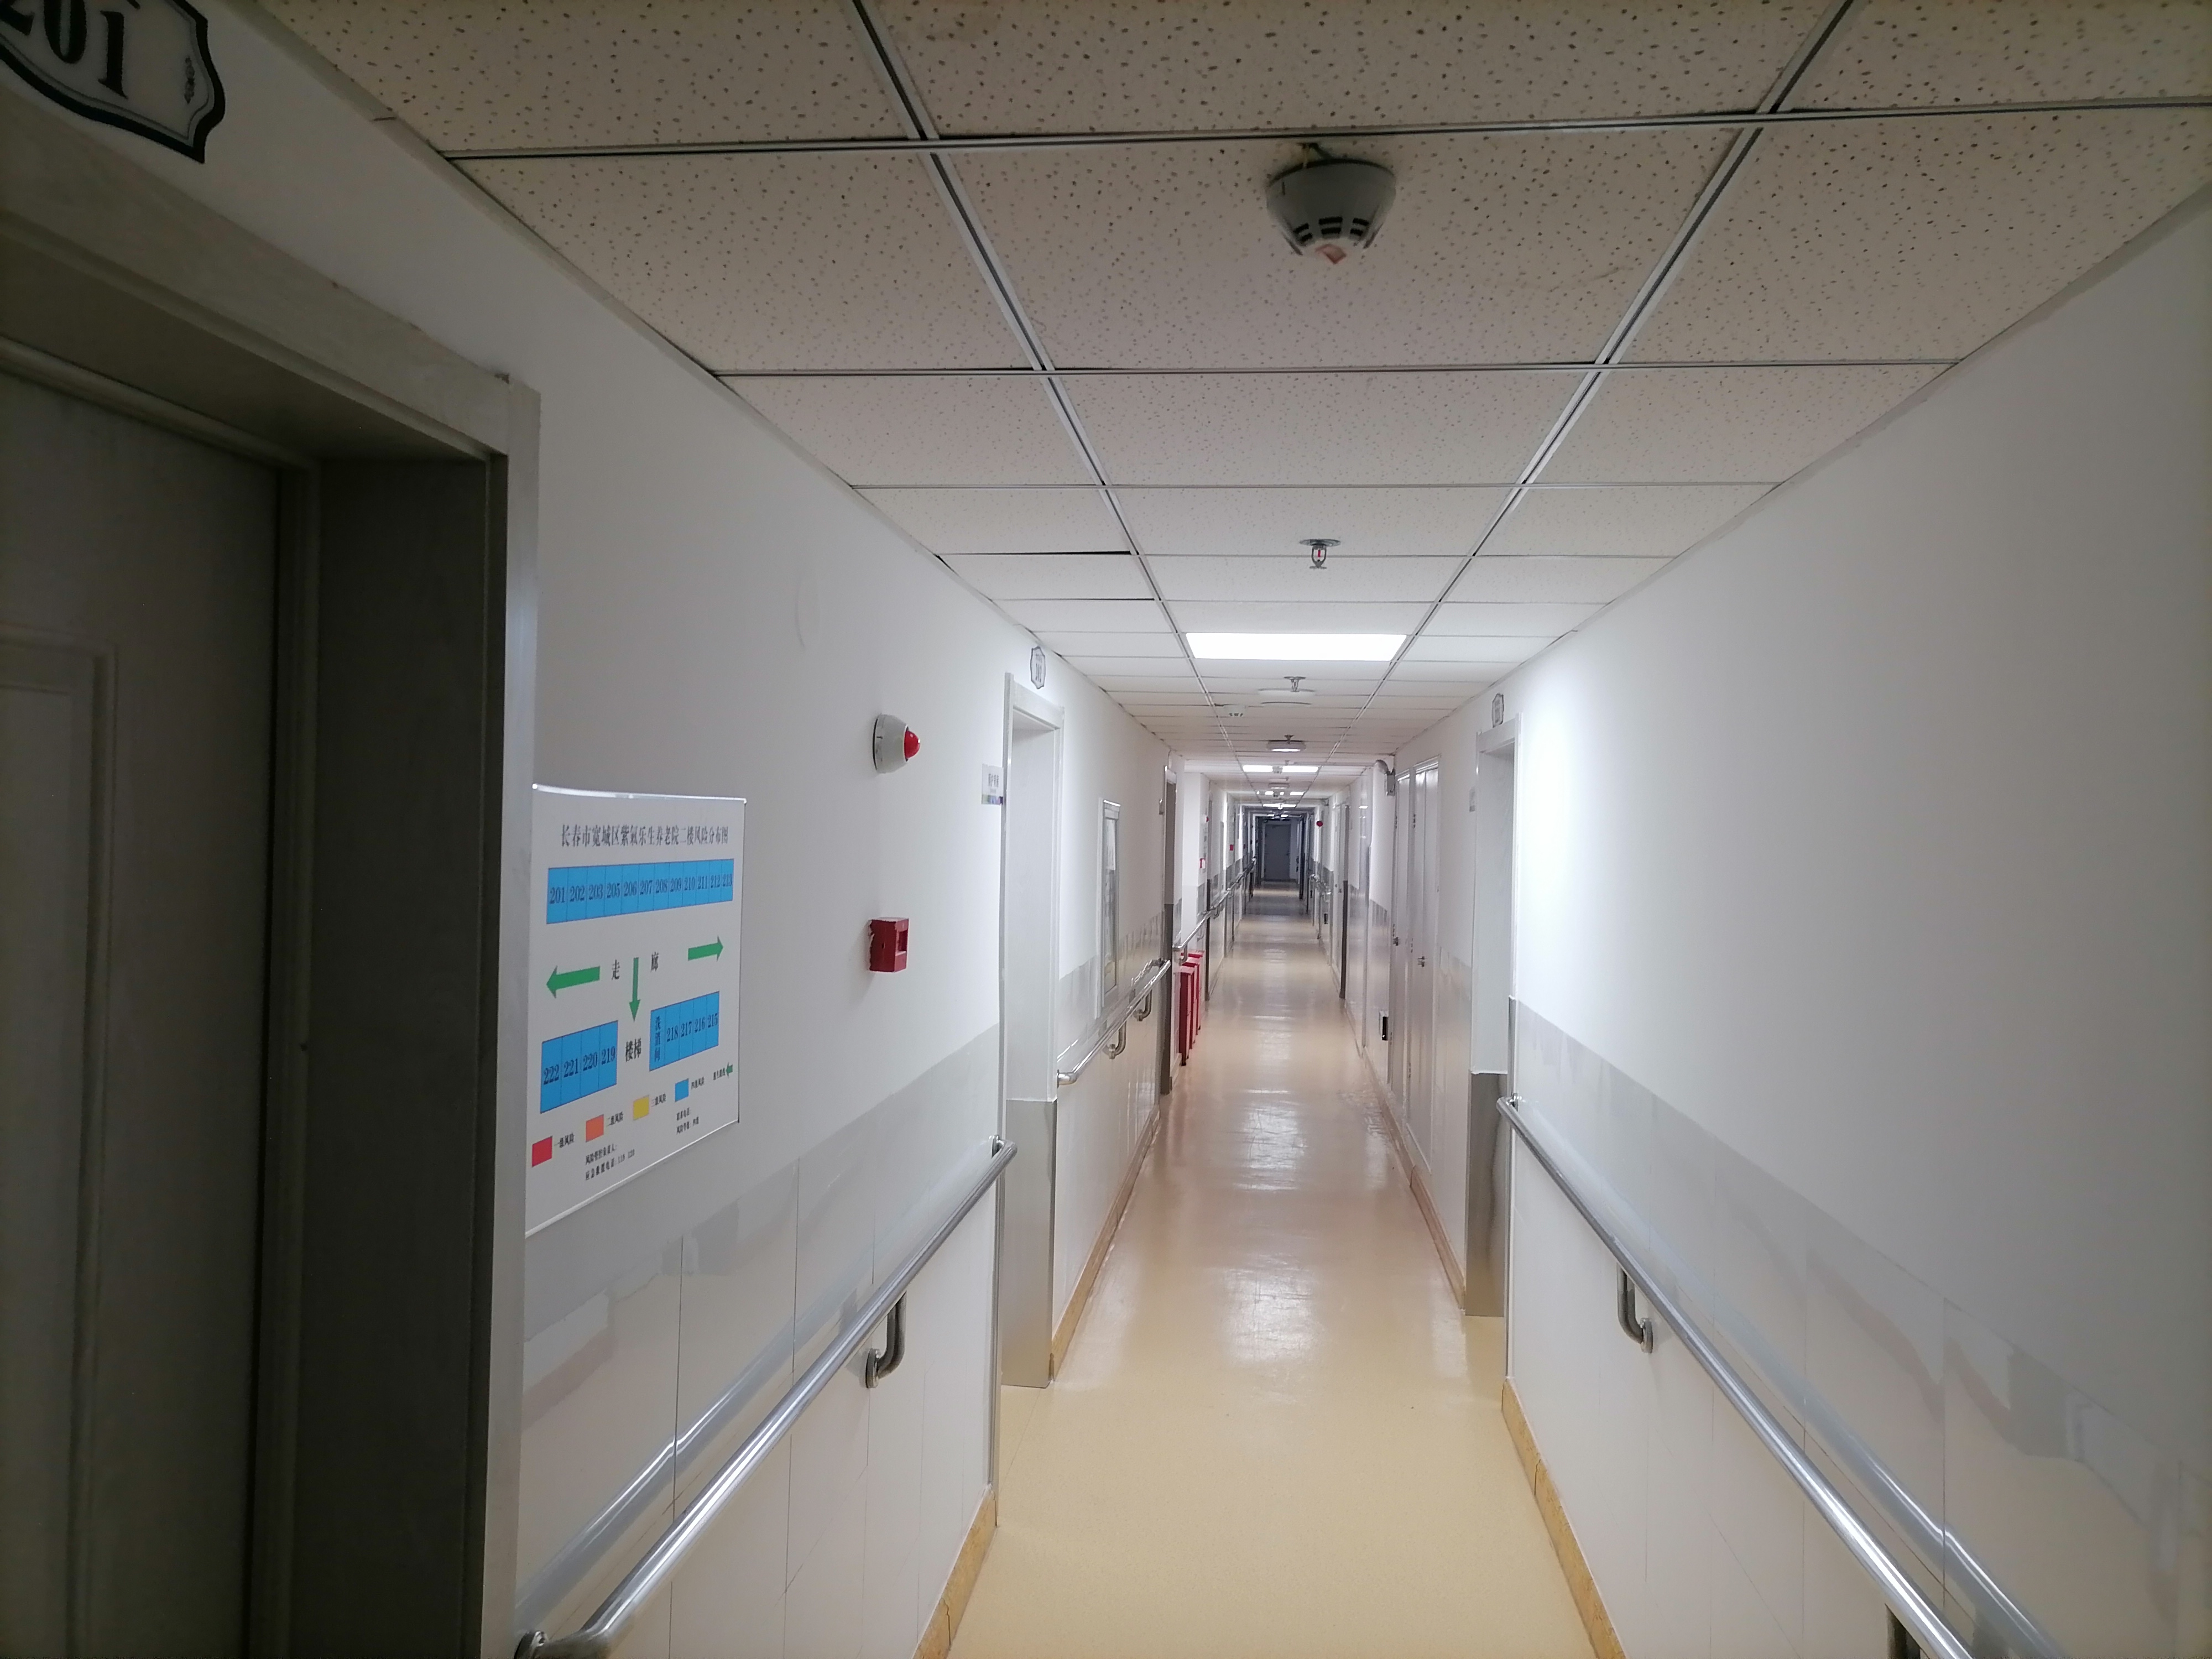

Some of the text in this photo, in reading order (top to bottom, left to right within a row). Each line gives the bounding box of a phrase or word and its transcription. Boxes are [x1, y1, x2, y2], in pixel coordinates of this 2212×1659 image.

[549, 873, 733, 904] 201 202 203 205 206 207 208 209 210 211 212 213
[666, 1013, 718, 1042] 218 217 216 215
[625, 1037, 642, 1062] 楼梯
[544, 1046, 615, 1085] 222 221 220 219
